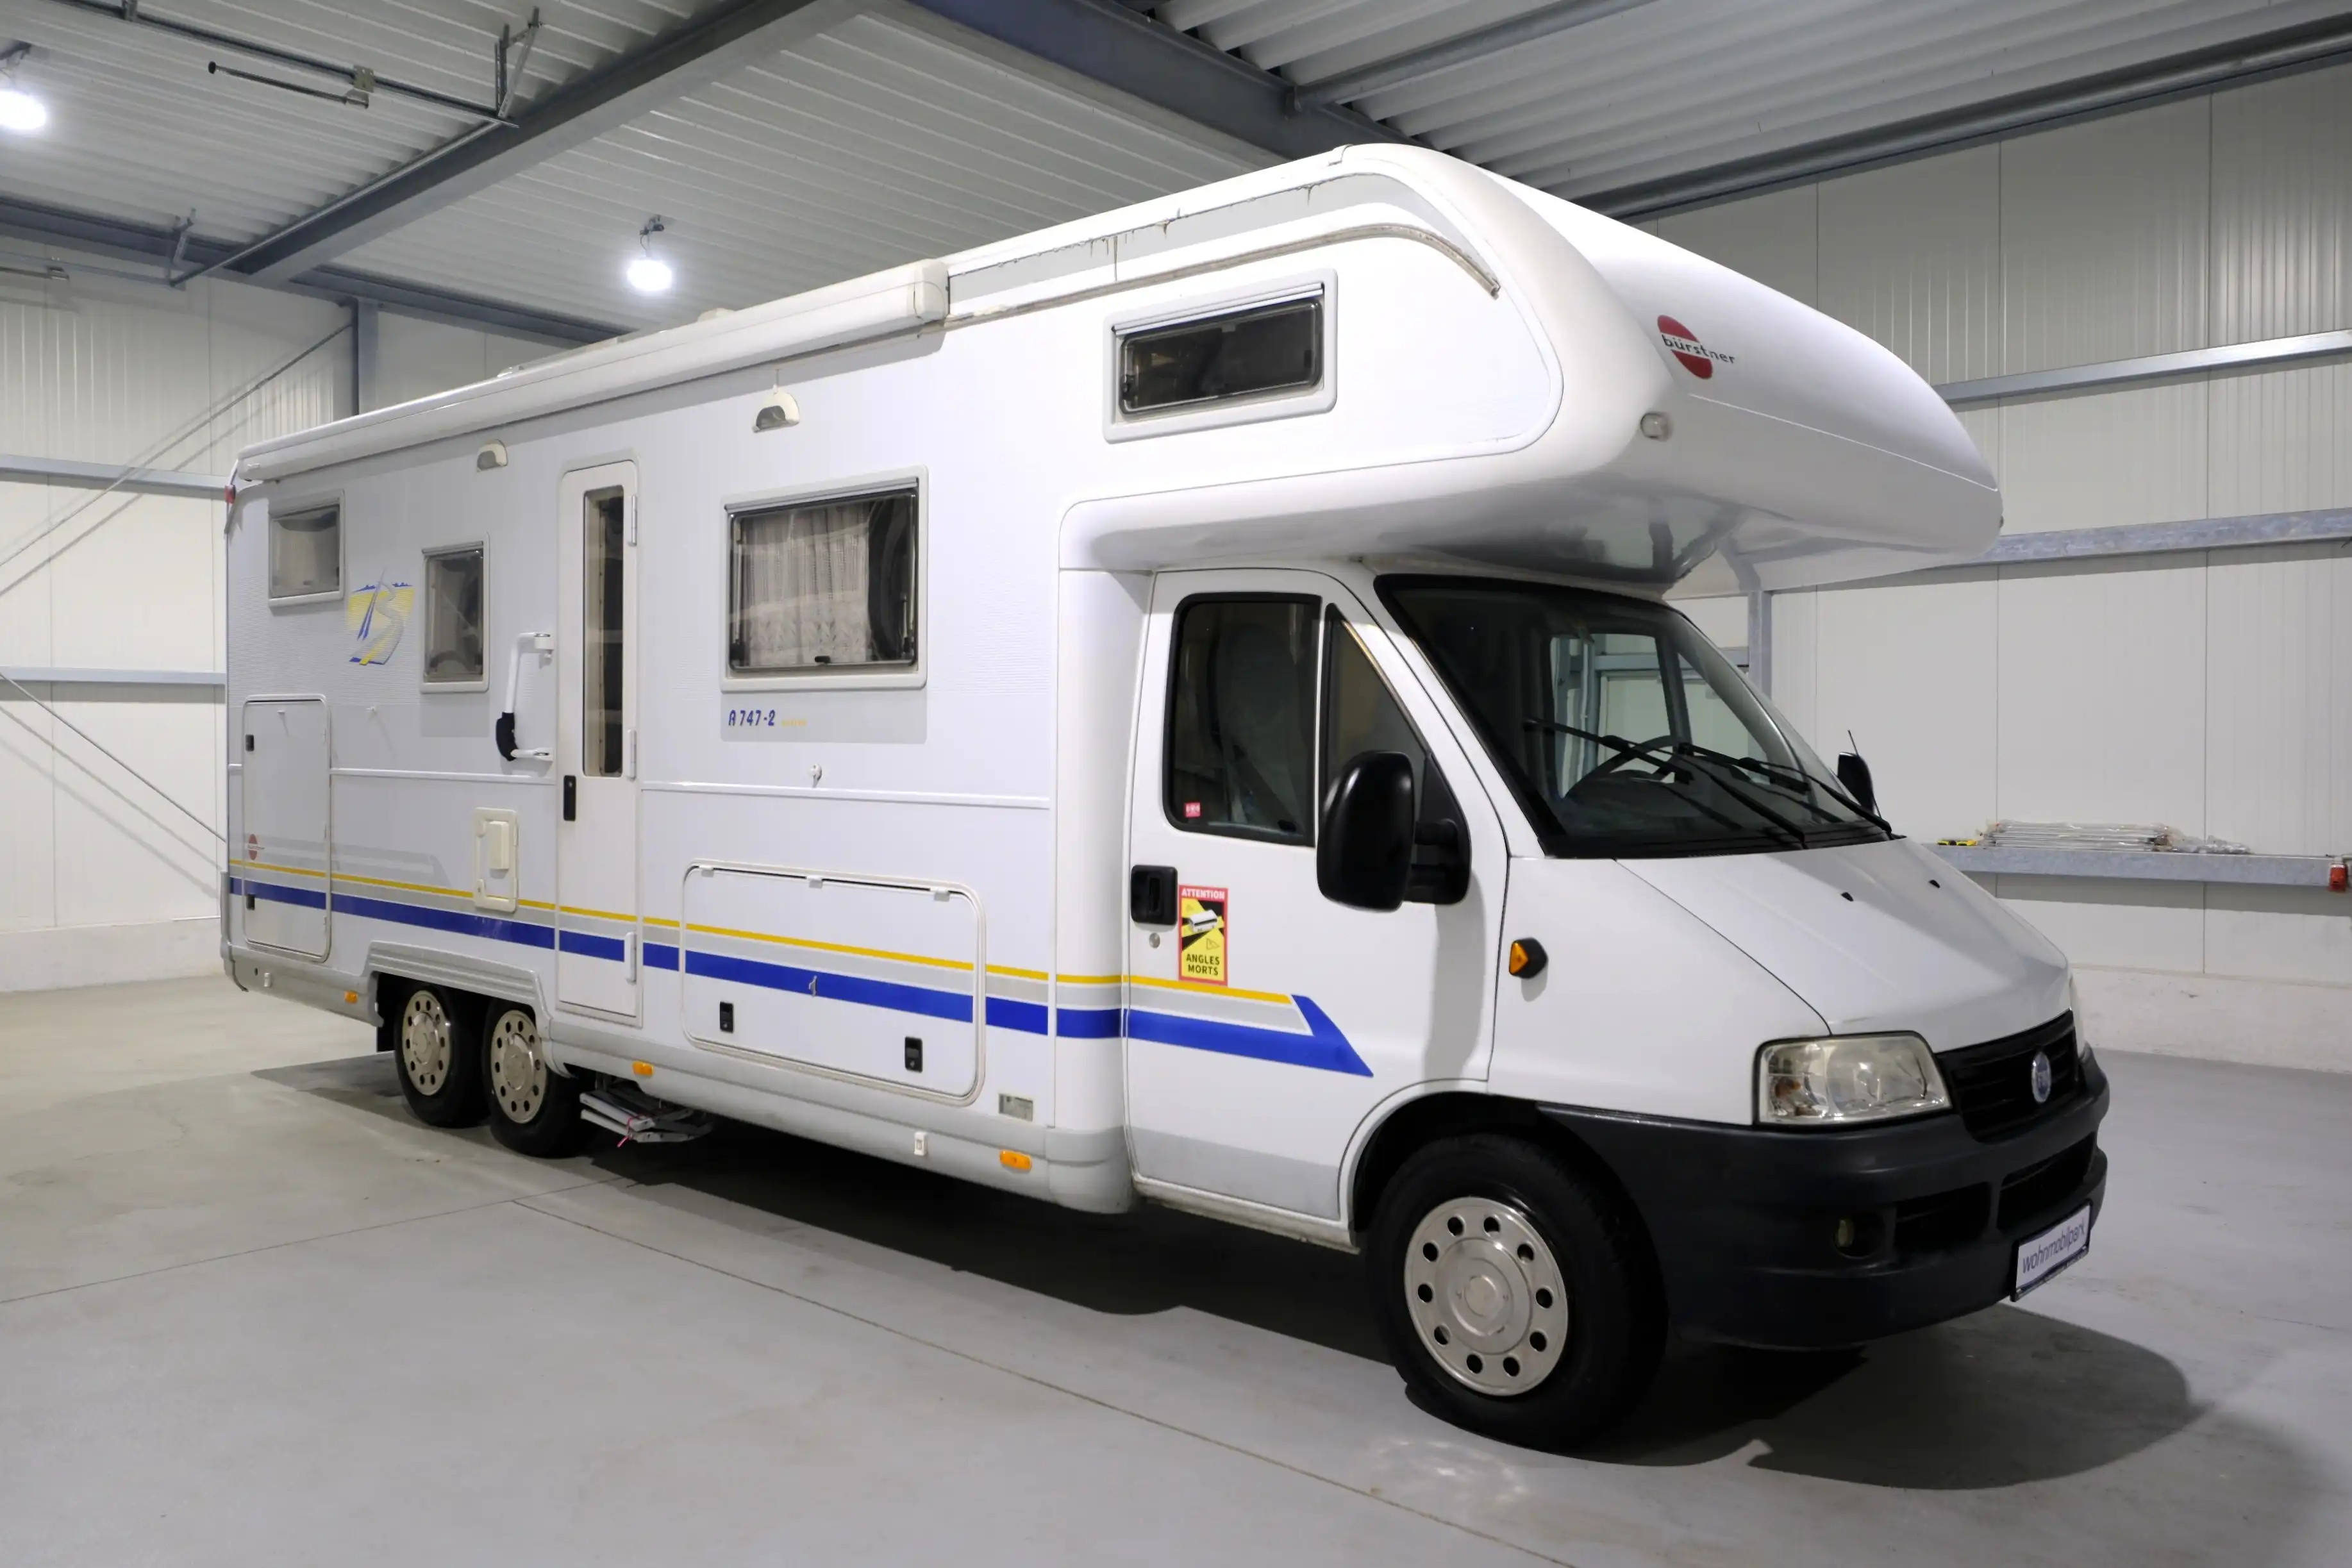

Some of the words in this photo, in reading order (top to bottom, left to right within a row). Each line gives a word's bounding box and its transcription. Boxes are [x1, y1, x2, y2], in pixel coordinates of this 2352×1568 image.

[1661, 334, 1735, 364] bürstner
[728, 710, 737, 726] A
[739, 709, 776, 726] 747-2
[1181, 888, 1225, 899] ATTENTION
[1186, 953, 1220, 965] ANGLES
[1188, 964, 1219, 976] MORTS
